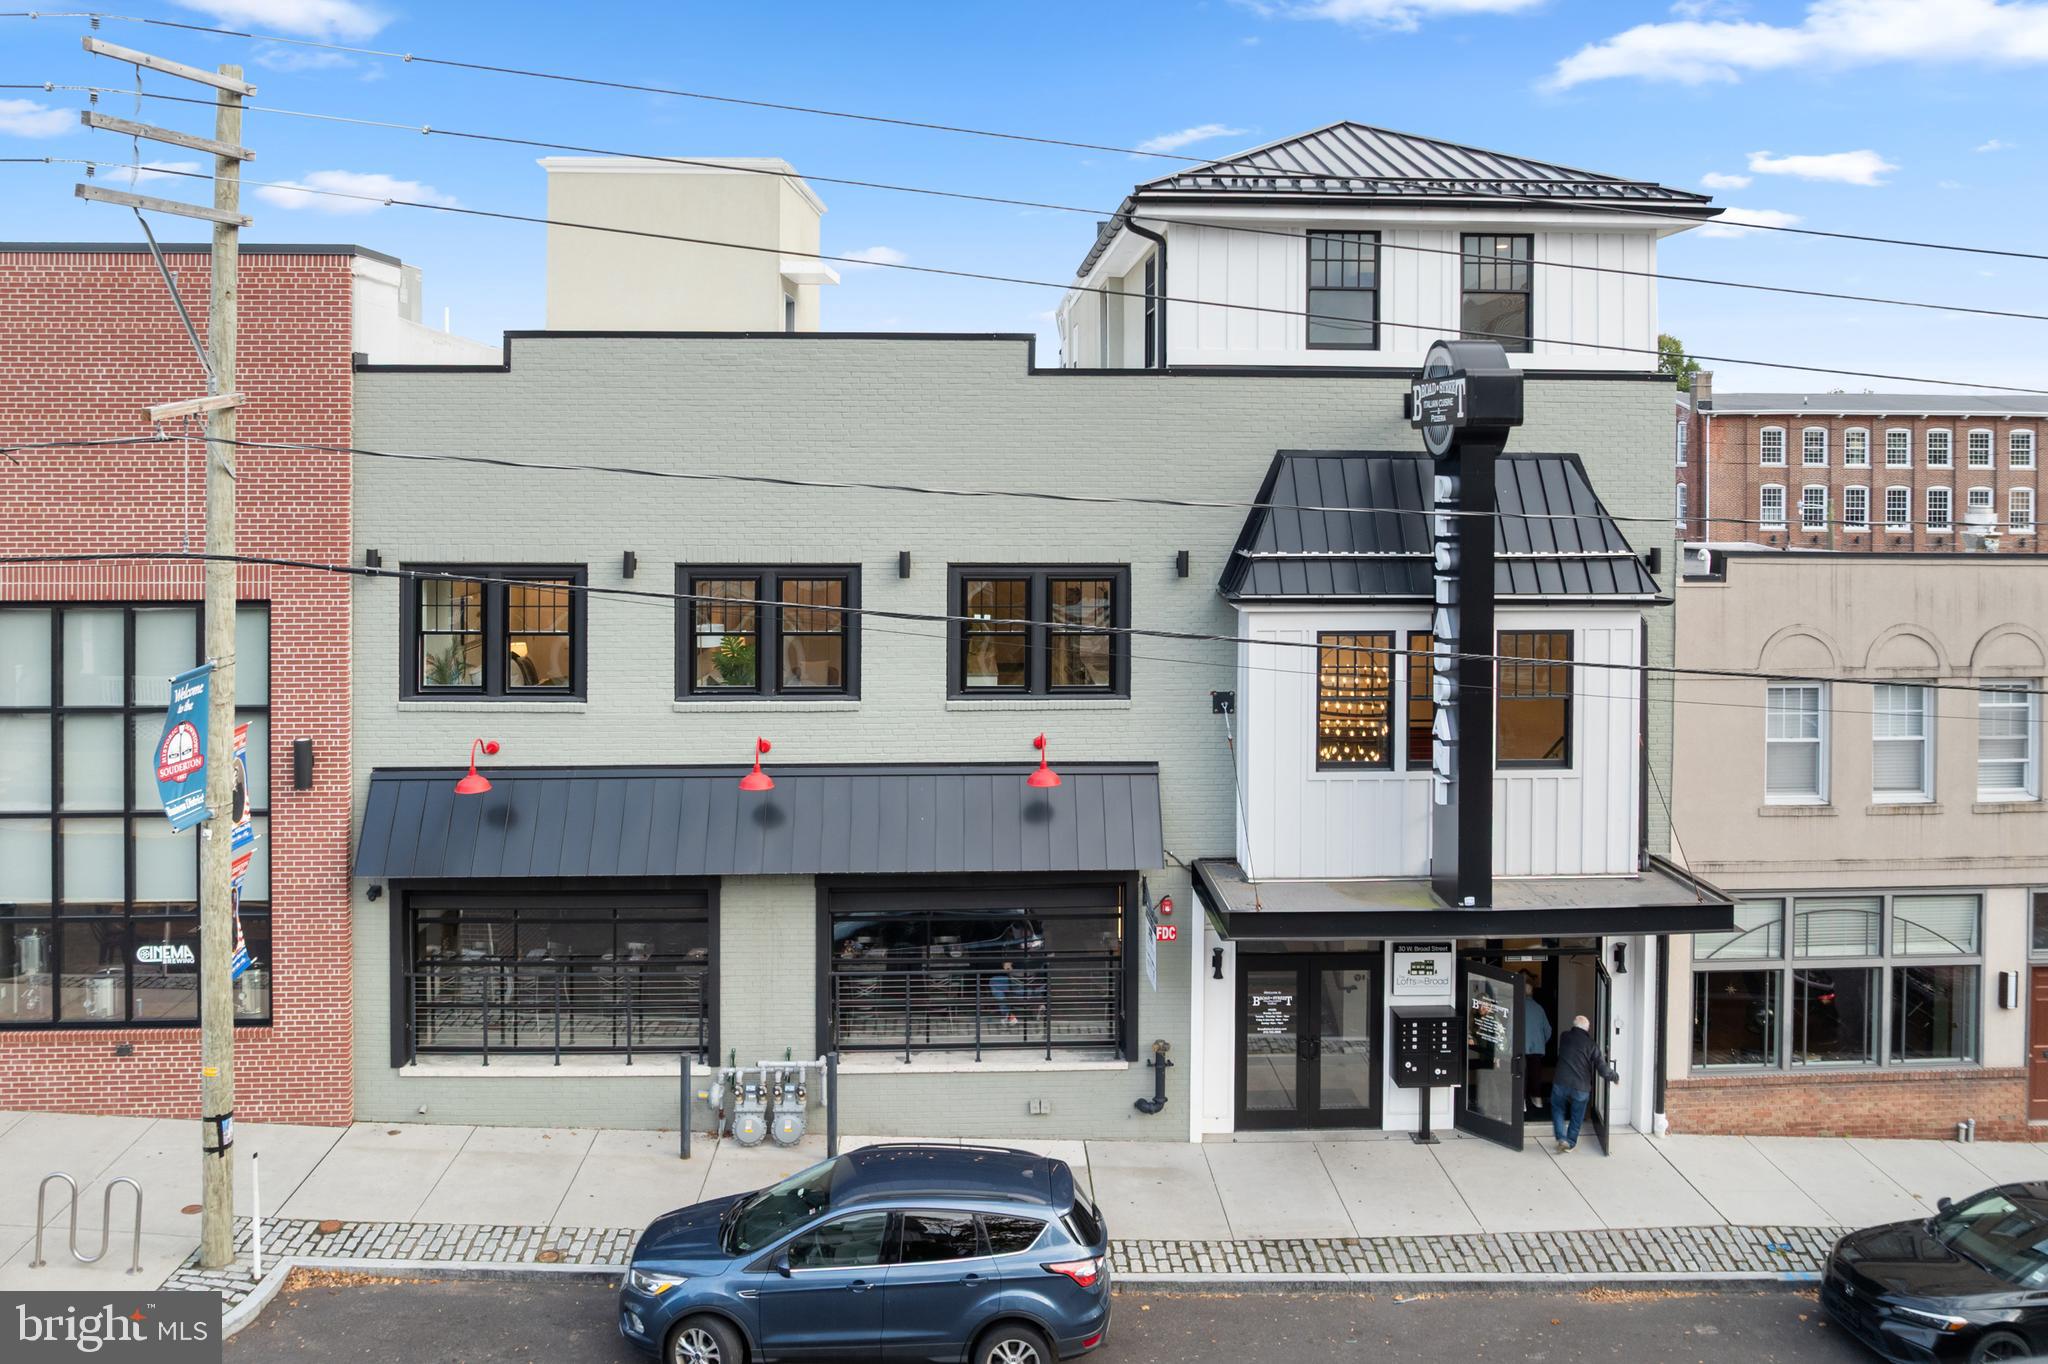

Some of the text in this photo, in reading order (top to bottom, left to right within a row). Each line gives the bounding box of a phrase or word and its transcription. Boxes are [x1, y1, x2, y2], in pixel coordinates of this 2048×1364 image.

[1412, 378, 1466, 421] BROAD STREET
[1423, 399, 1439, 409] ITALIAN
[174, 683, 205, 703] Welcome
[184, 699, 194, 711] the
[161, 725, 179, 764] HISTORIC
[159, 757, 203, 778] SOUDERTON
[185, 793, 204, 808] District
[1156, 926, 1176, 940] FDC
[136, 945, 195, 962] CINEMA
[1397, 977, 1417, 985] Lofts
[1424, 976, 1449, 985] Broad
